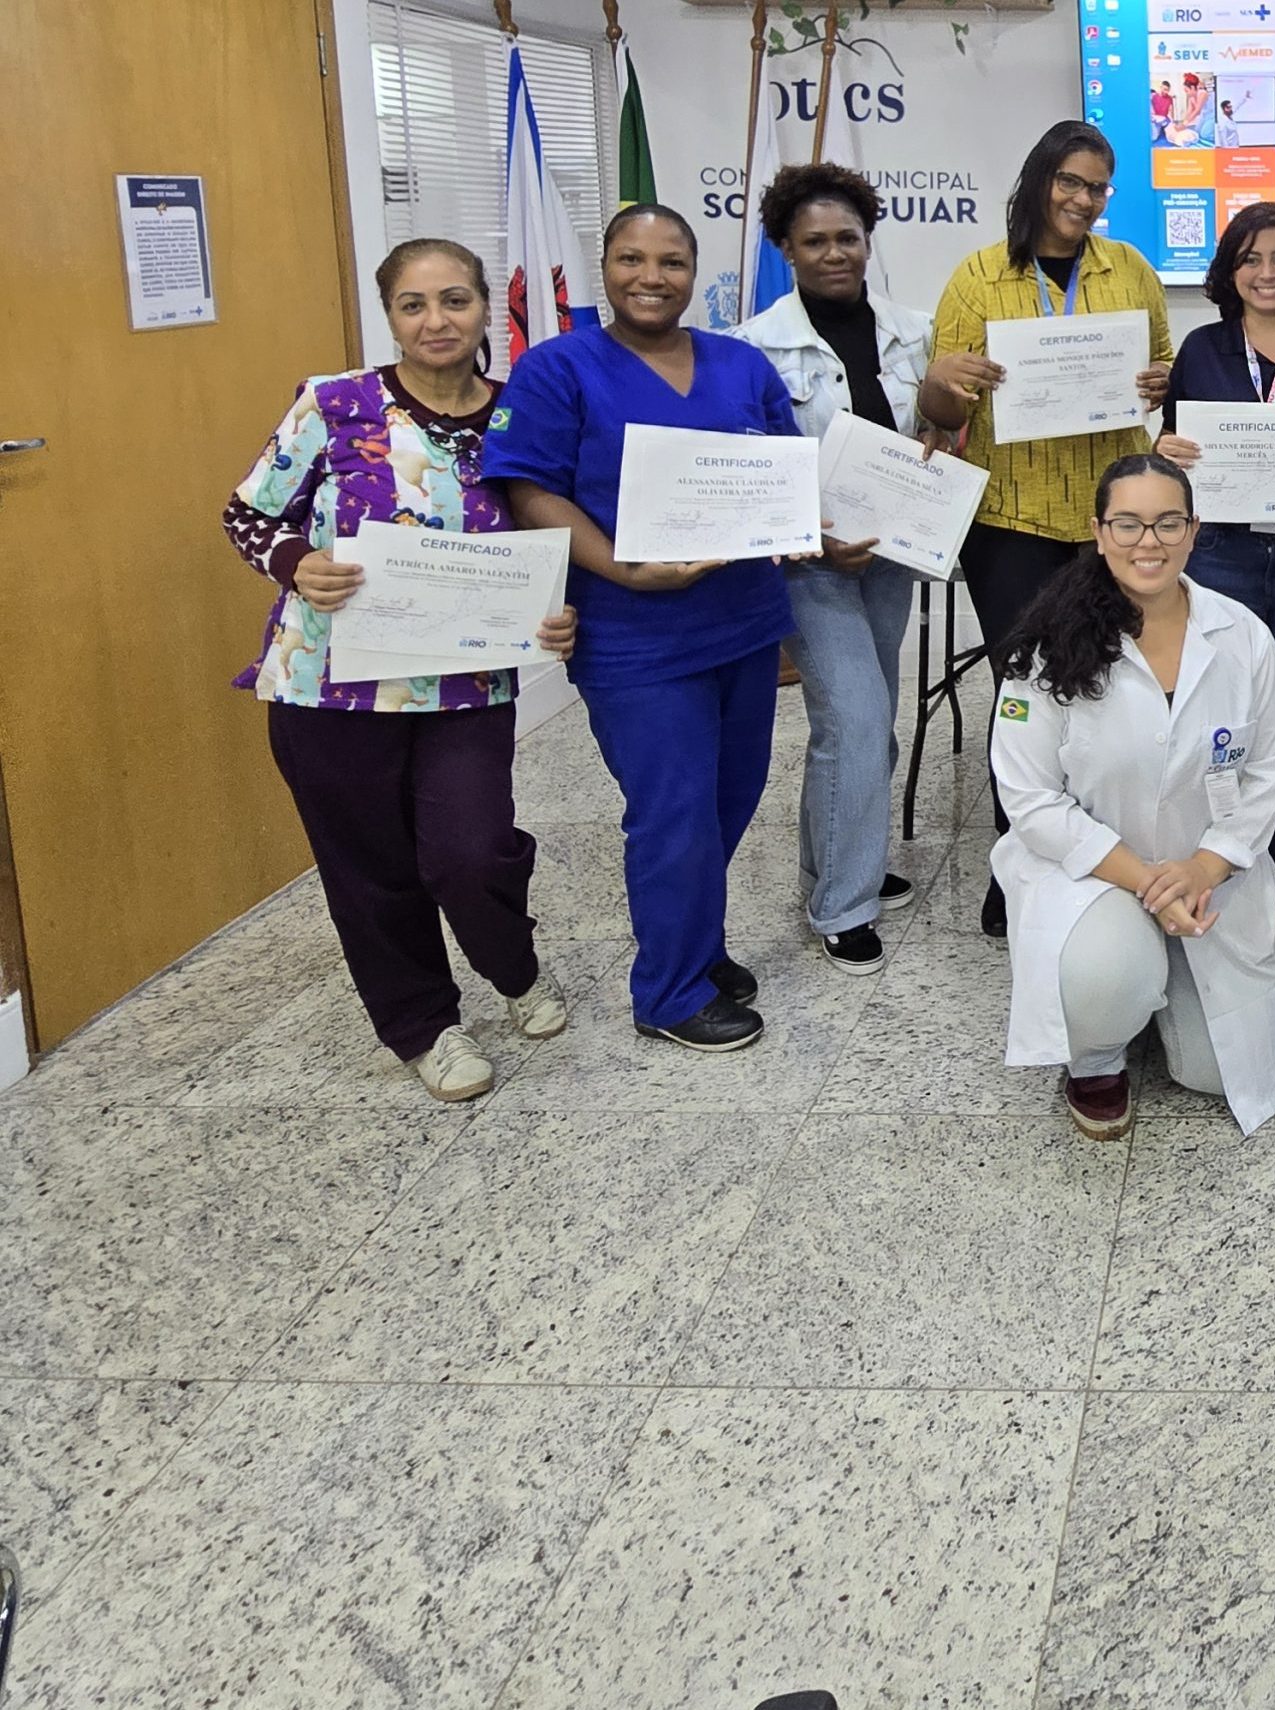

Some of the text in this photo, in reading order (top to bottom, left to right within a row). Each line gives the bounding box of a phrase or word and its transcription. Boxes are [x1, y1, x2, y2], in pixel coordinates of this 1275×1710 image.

[1175, 9, 1202, 22] RIO
[1174, 50, 1209, 60] SBVE
[769, 78, 905, 122] tcs
[860, 170, 979, 191] UNICIPAL
[1039, 333, 1103, 346] CERTIFICADO
[695, 456, 773, 468] CERTIFICADO
[881, 446, 944, 477] CERTIFICADO
[420, 538, 512, 557] CERTIFICADO
[438, 564, 476, 576] AMARO
[468, 639, 487, 649] RIO
